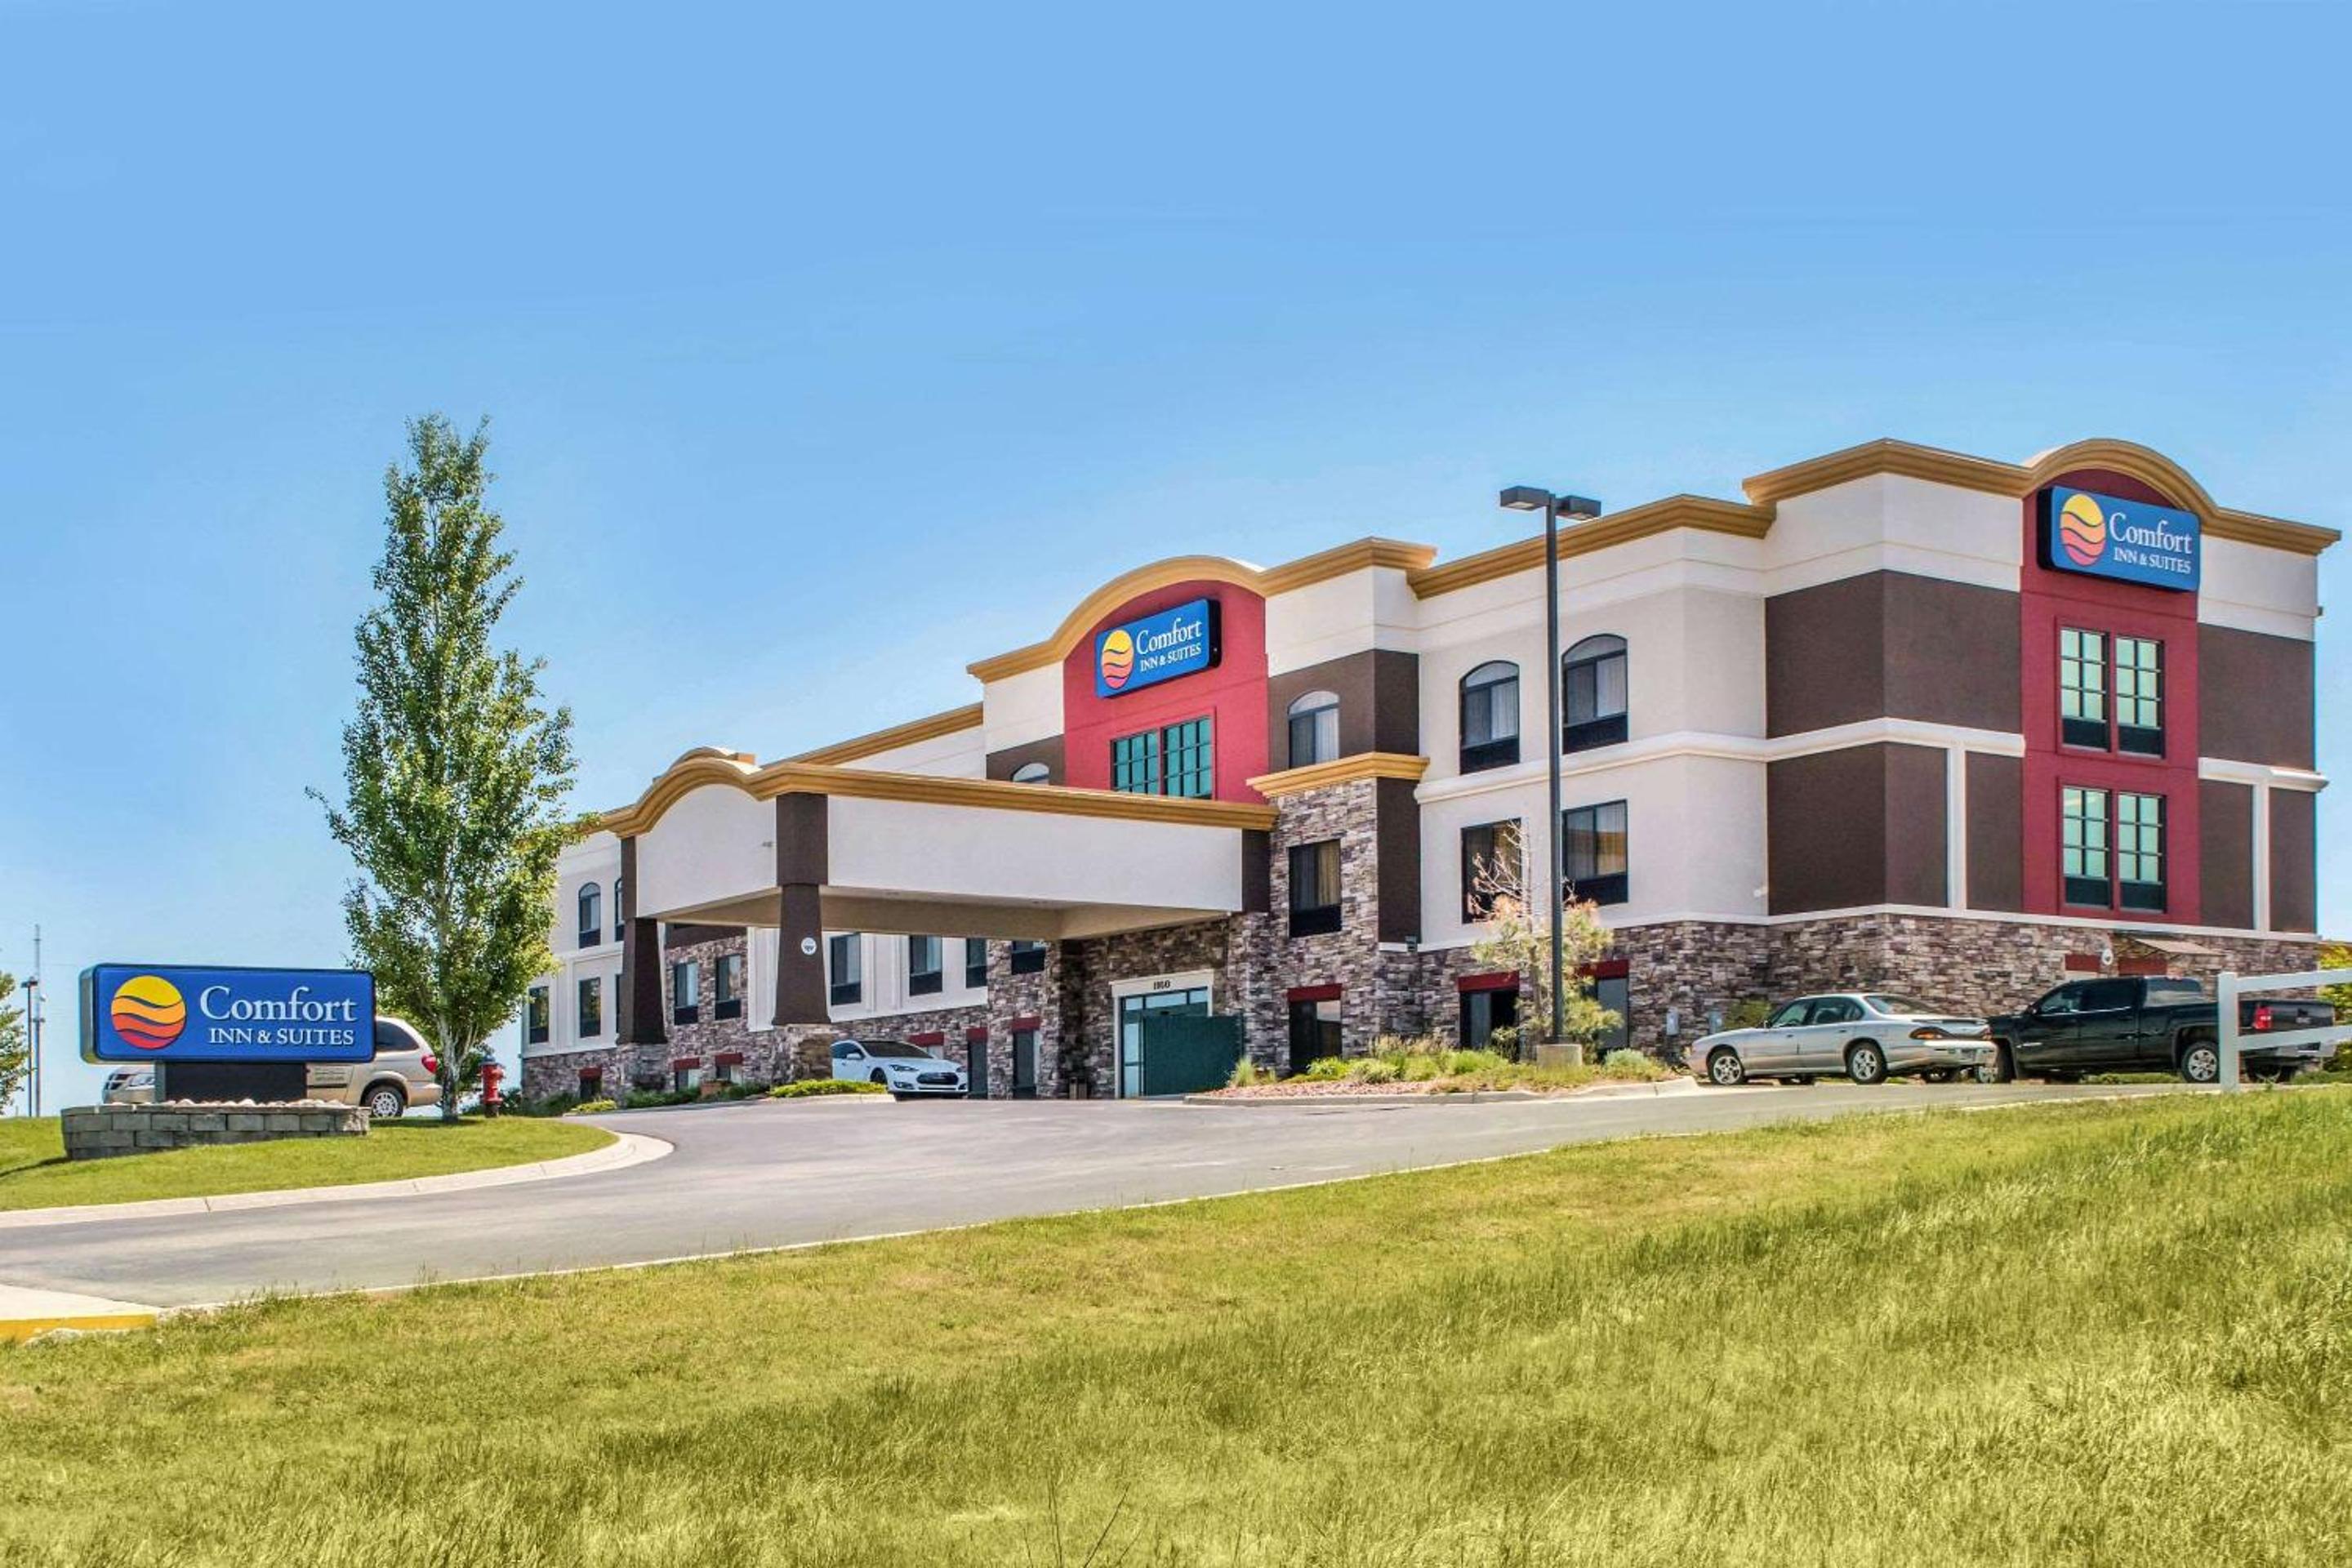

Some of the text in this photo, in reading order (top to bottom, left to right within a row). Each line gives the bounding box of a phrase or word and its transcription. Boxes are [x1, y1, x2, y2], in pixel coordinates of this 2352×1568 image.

[2109, 512, 2193, 554] Comfort
[2114, 547, 2191, 574] INN & SUITES
[1136, 617, 1202, 654] Comfort
[1140, 642, 1201, 671] INN & SUITES
[200, 986, 357, 1021] Comfort
[210, 1028, 354, 1045] INN & SUITES
